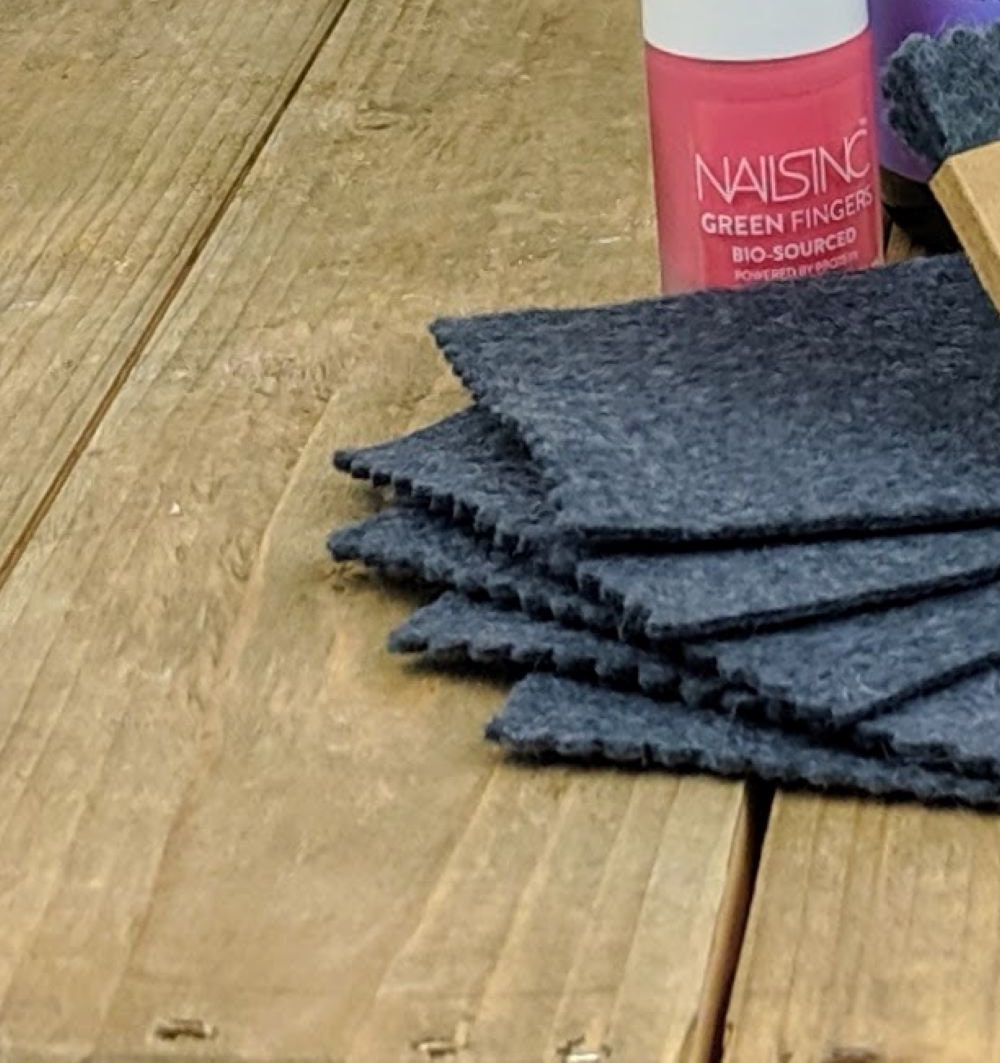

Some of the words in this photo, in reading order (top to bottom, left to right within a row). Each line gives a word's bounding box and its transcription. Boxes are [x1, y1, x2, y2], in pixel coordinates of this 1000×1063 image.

[701, 211, 784, 237] GREEN
[791, 185, 873, 233] FINGERS
[732, 226, 857, 263] BIO-SOURCED
[734, 266, 796, 282] POWERED
